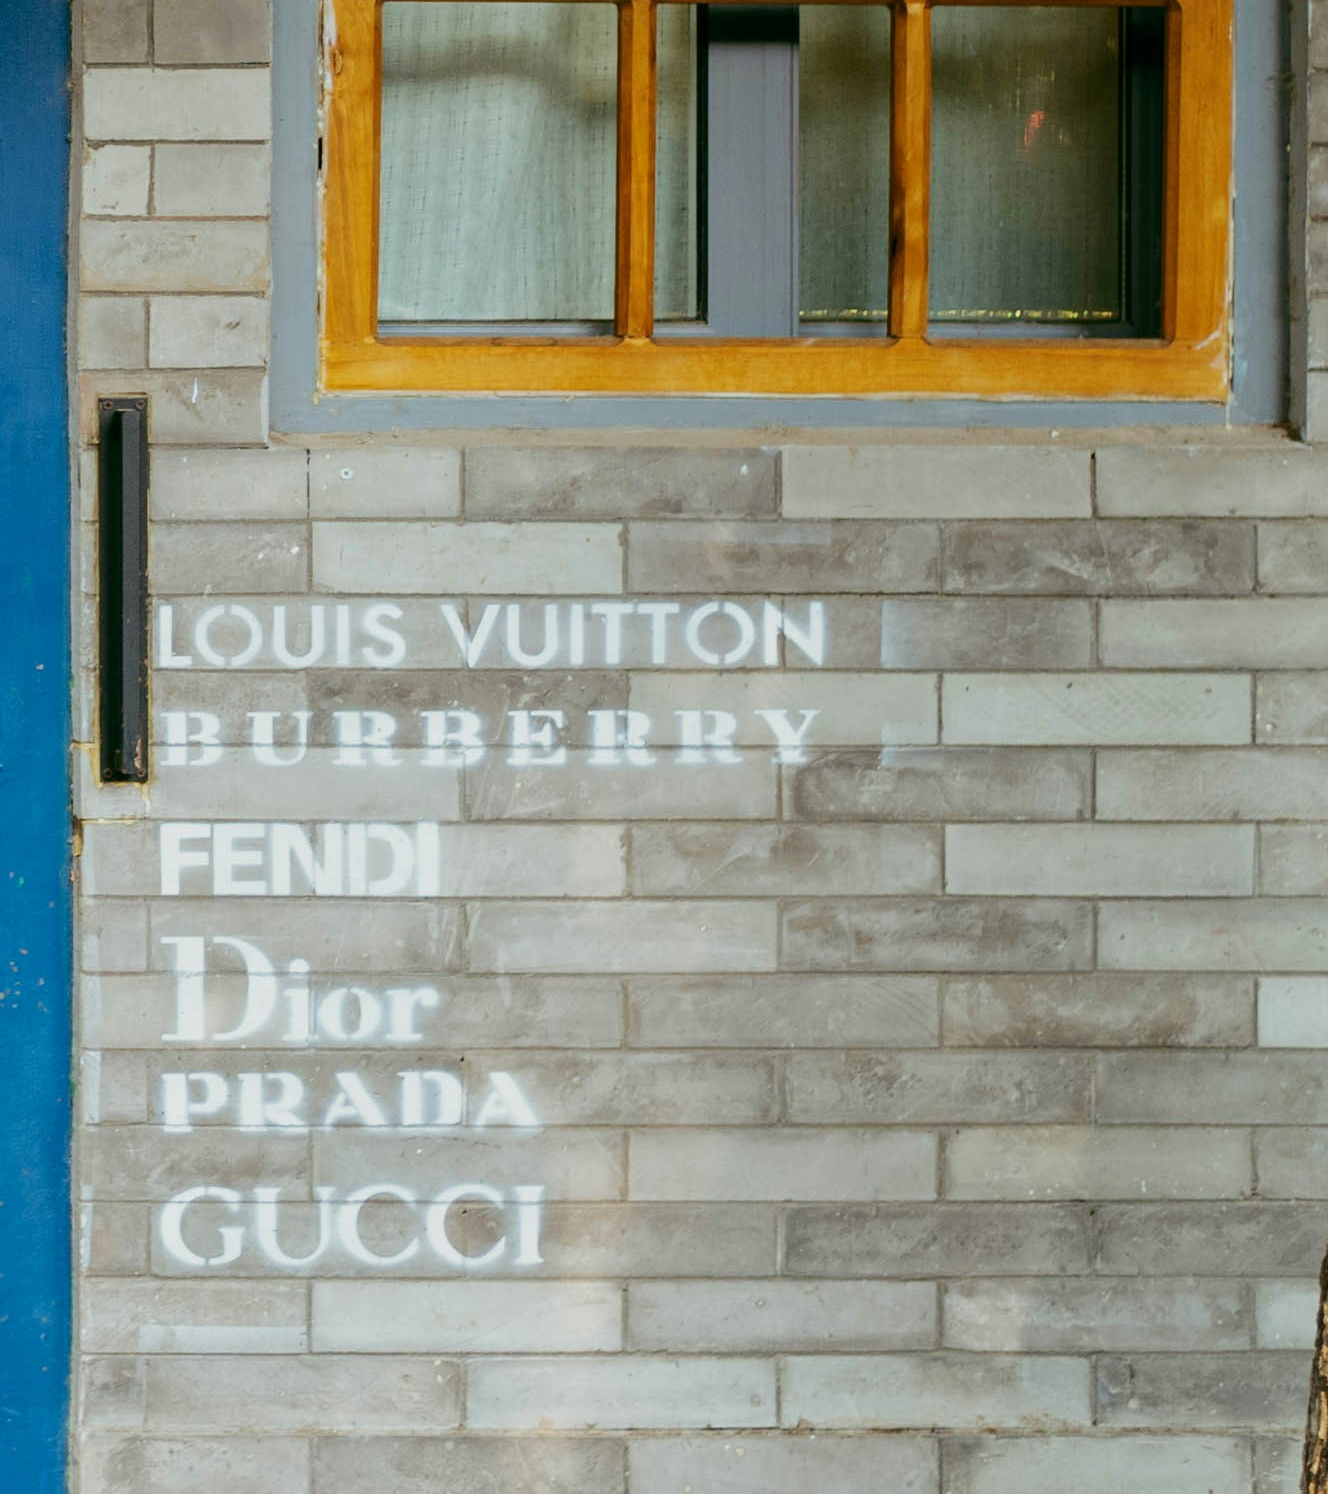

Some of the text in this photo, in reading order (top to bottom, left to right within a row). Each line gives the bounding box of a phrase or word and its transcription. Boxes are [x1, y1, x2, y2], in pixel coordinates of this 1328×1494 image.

[159, 602, 825, 669] LOUIS VUITTON
[159, 709, 821, 767] BURBERRY
[159, 822, 440, 896] FENDI
[160, 935, 440, 1043] Dior
[159, 1071, 544, 1133] PRADA
[159, 1185, 545, 1266] GUCCI
